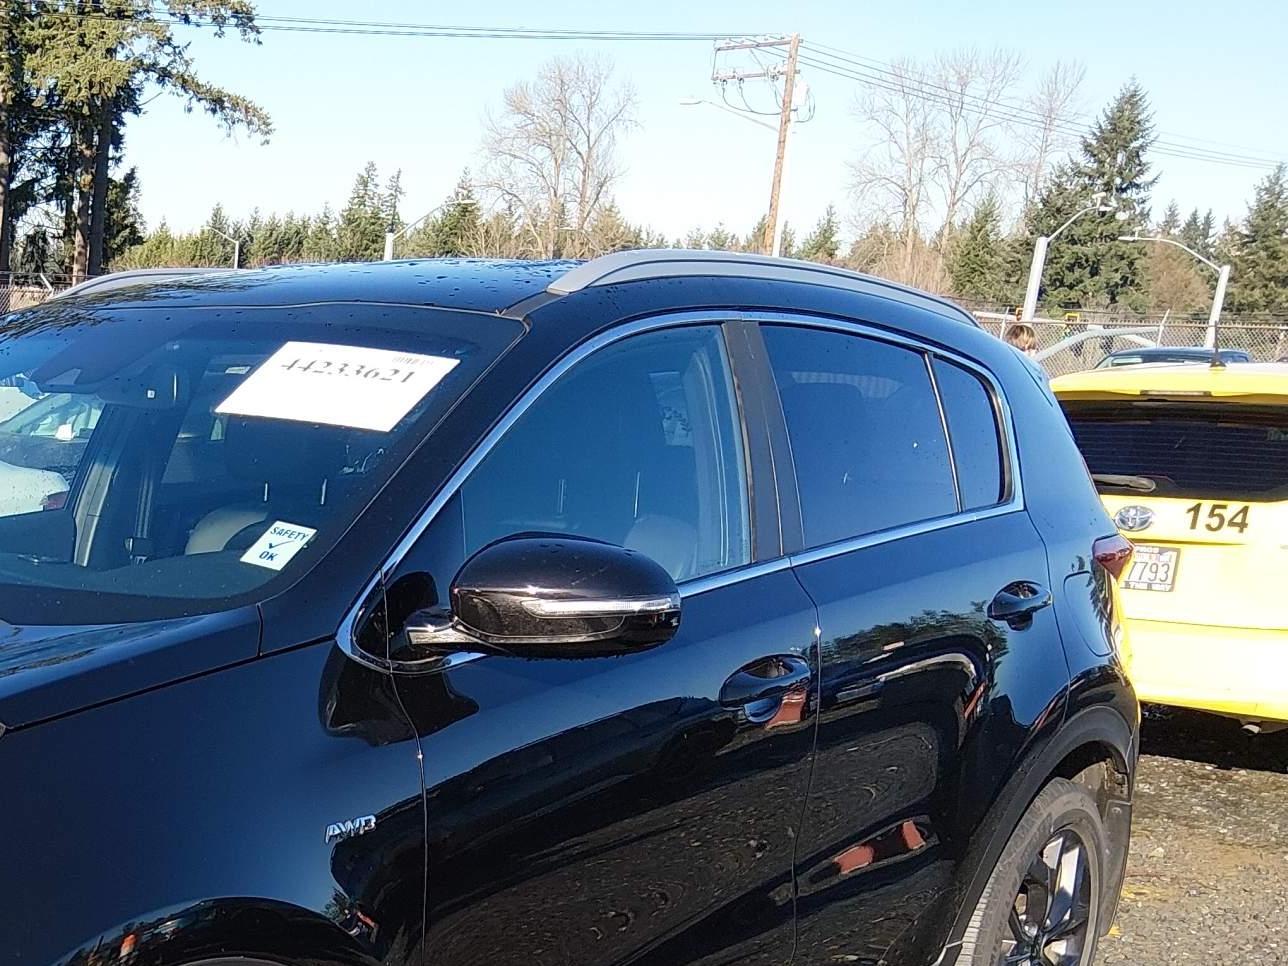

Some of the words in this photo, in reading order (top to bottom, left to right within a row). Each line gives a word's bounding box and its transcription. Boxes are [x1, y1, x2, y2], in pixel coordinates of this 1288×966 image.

[281, 358, 416, 384] 44233621
[1185, 502, 1251, 534] 154
[270, 526, 309, 541] SAFETY
[258, 550, 279, 562] OK
[325, 814, 377, 844] AWD
